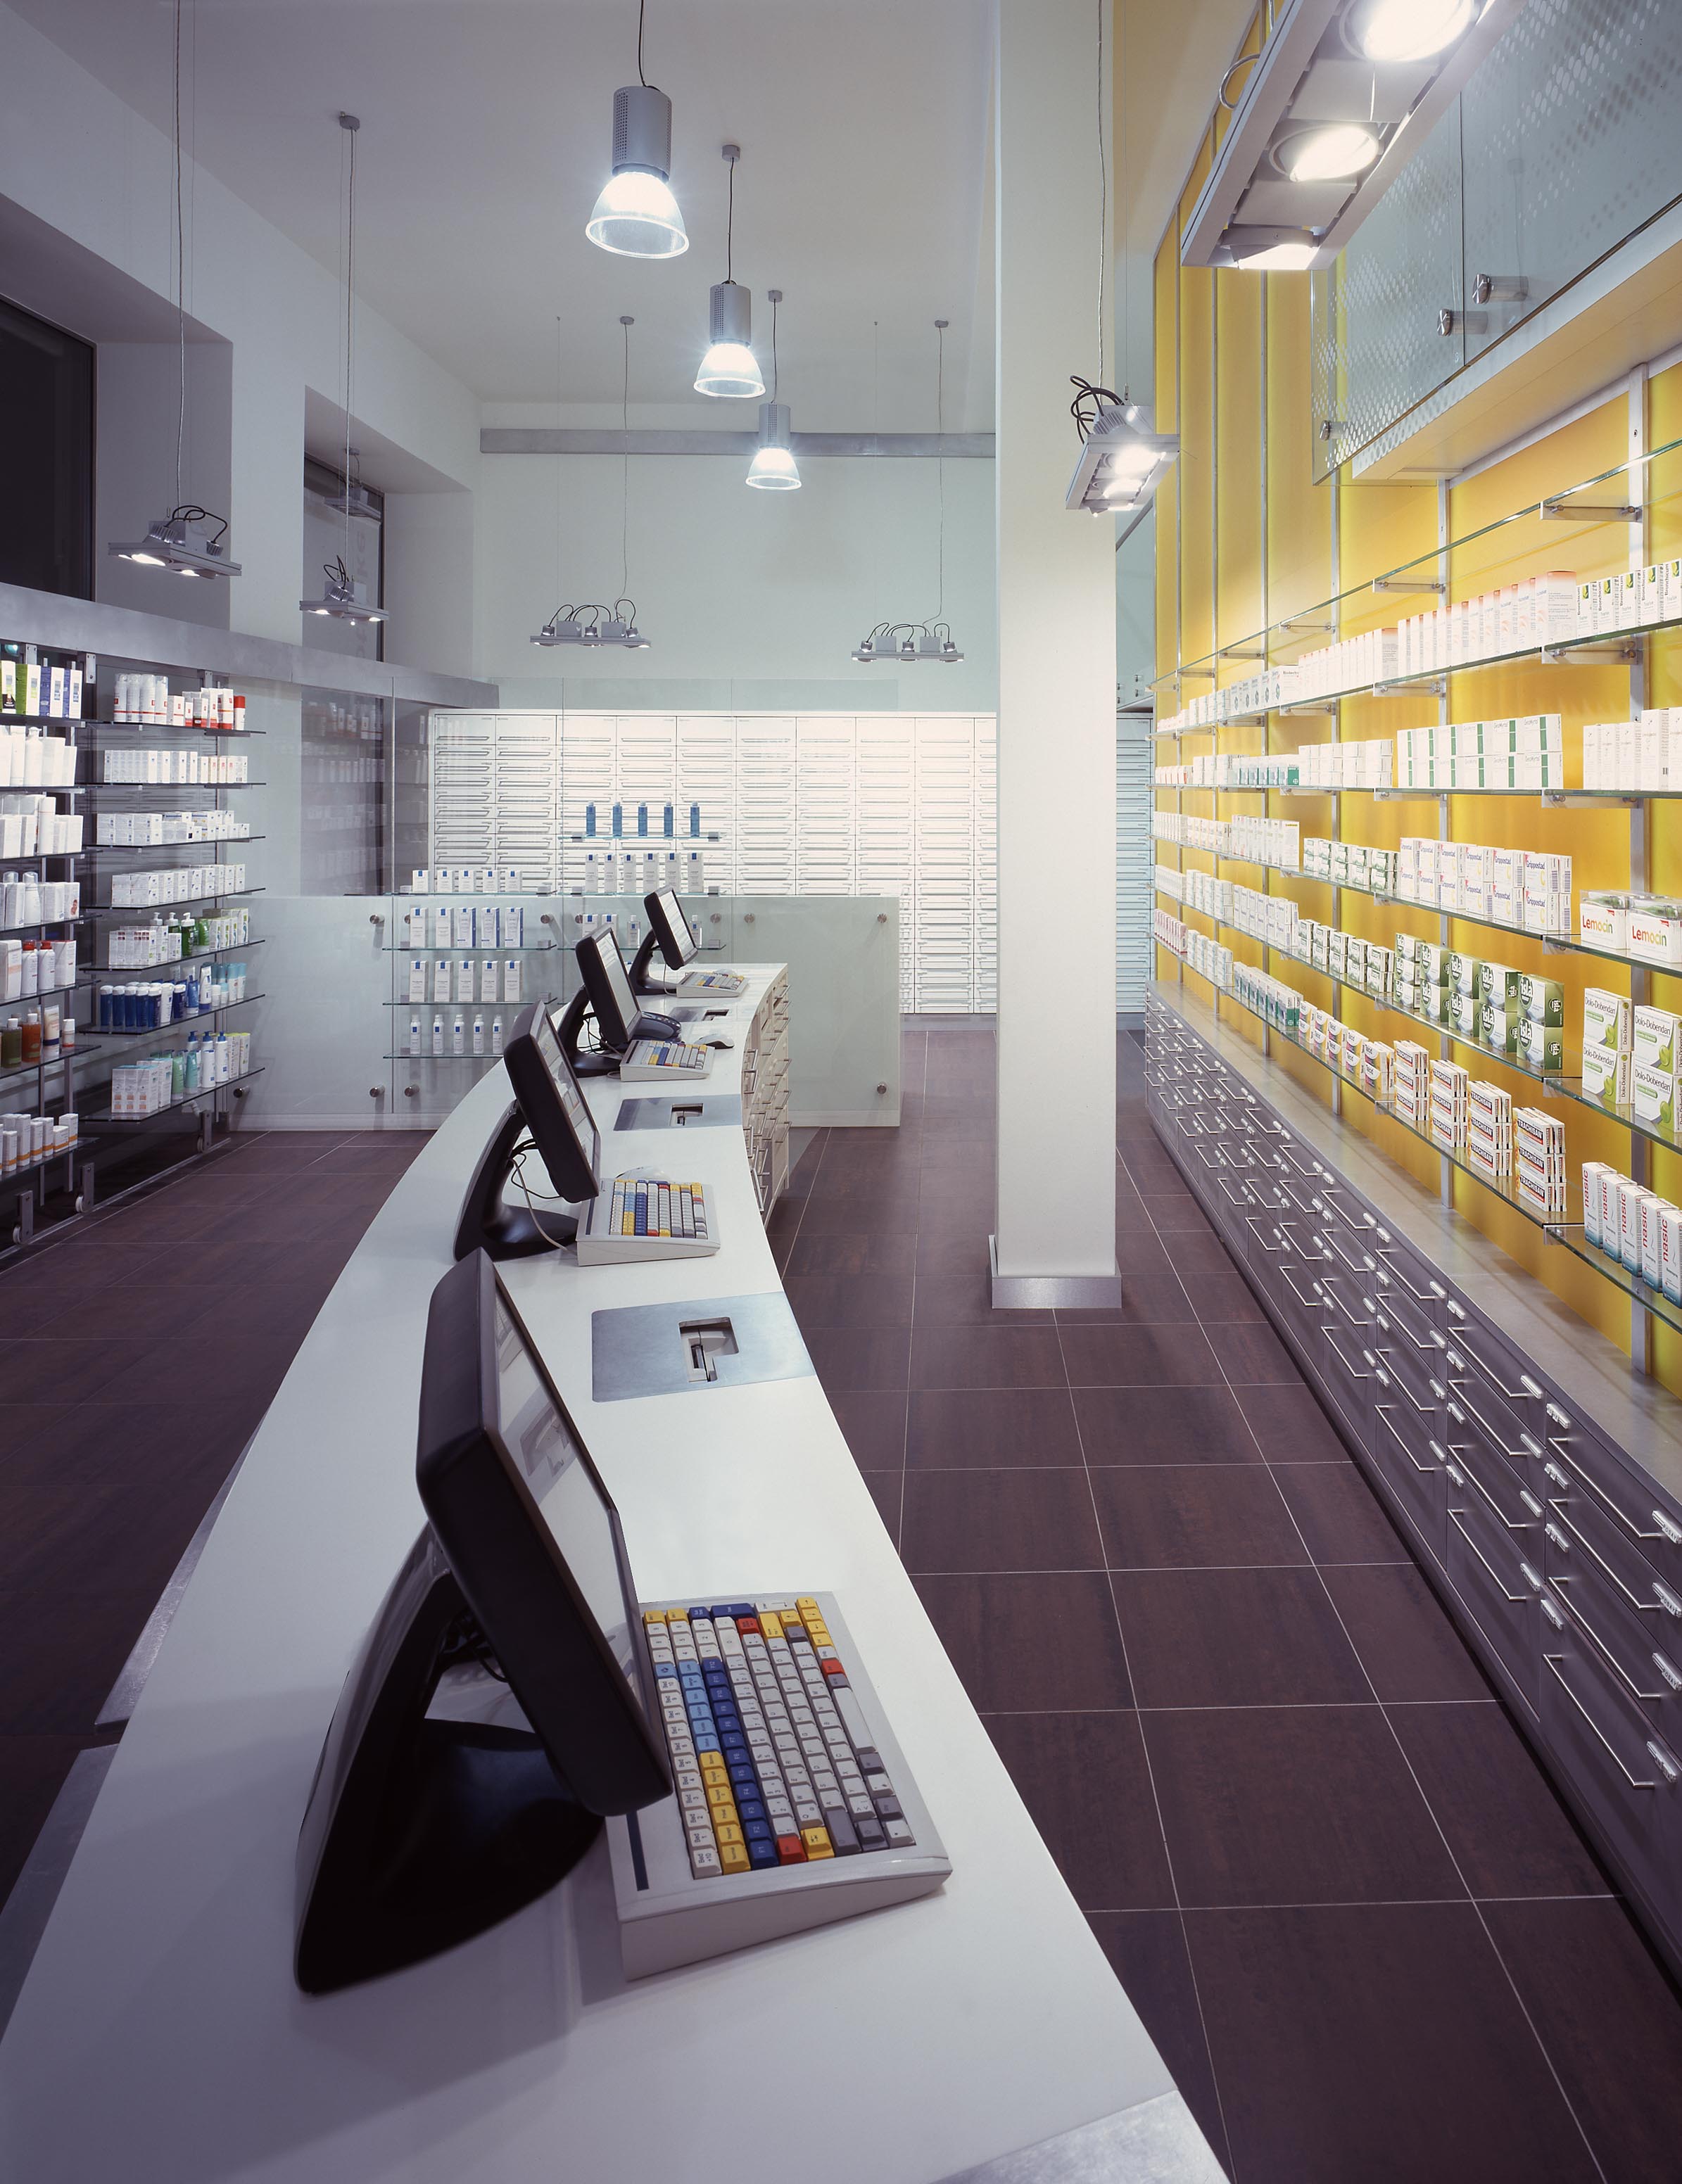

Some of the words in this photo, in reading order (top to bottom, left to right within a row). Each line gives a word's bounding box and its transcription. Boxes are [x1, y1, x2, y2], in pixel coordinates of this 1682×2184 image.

[1495, 856, 1512, 865] Grippostad
[1526, 860, 1545, 870] Grippostad
[1494, 890, 1511, 901] Grippostad
[1527, 896, 1545, 908] Grippostad
[1583, 915, 1613, 934] Lemocin
[1633, 925, 1667, 947] Lemocin
[1422, 946, 1431, 963] isla
[1451, 956, 1462, 974] isla
[1481, 967, 1493, 985] isla
[1422, 981, 1431, 999] isla
[1521, 979, 1533, 998] isla
[1452, 992, 1463, 1012] isla
[1585, 997, 1616, 1014] Dolo-Dobendan
[1481, 1006, 1494, 1025] isla
[1519, 1020, 1532, 1041] isla
[1636, 1015, 1671, 1036] Dolo-Dobendan
[1584, 1047, 1614, 1067] Dolo-Dobendan
[1636, 1069, 1671, 1091] Dolo-Dobendan
[1518, 1119, 1543, 1140] TRACHISAN
[1519, 1148, 1544, 1169] TRACHISAN
[1520, 1176, 1545, 1198] TRACHISAN
